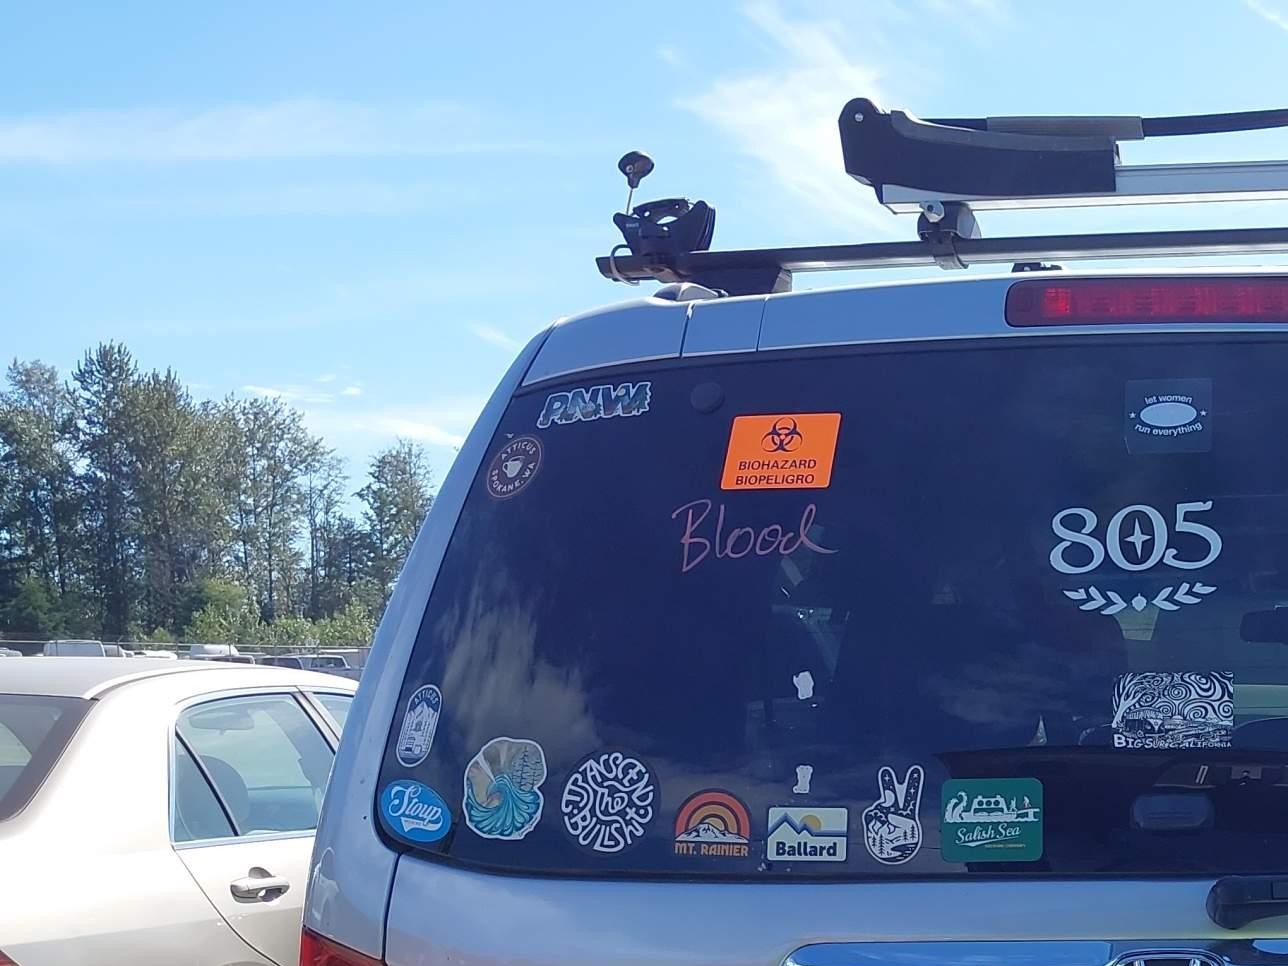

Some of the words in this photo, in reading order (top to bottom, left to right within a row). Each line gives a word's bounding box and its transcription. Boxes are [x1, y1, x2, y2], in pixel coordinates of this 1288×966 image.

[537, 382, 651, 428] PNW
[1144, 396, 1157, 405] let
[1158, 395, 1193, 404] women
[1135, 424, 1151, 434] run
[1152, 422, 1203, 437] everything
[501, 441, 537, 460] ATTICUS
[521, 462, 537, 478] WA
[738, 459, 817, 471] BIOHAZARD
[735, 474, 815, 486] BIOPELIGRO
[671, 499, 840, 573] Blood
[1050, 501, 1223, 574] 805
[414, 688, 440, 706] ATTICUS
[1113, 733, 1145, 749] BIG
[389, 785, 444, 827] Stoup
[955, 824, 995, 844] Salish
[996, 822, 1021, 839] Sea
[674, 843, 697, 856] MT.
[700, 843, 749, 857] RAINIER
[775, 841, 838, 857] Ballard
